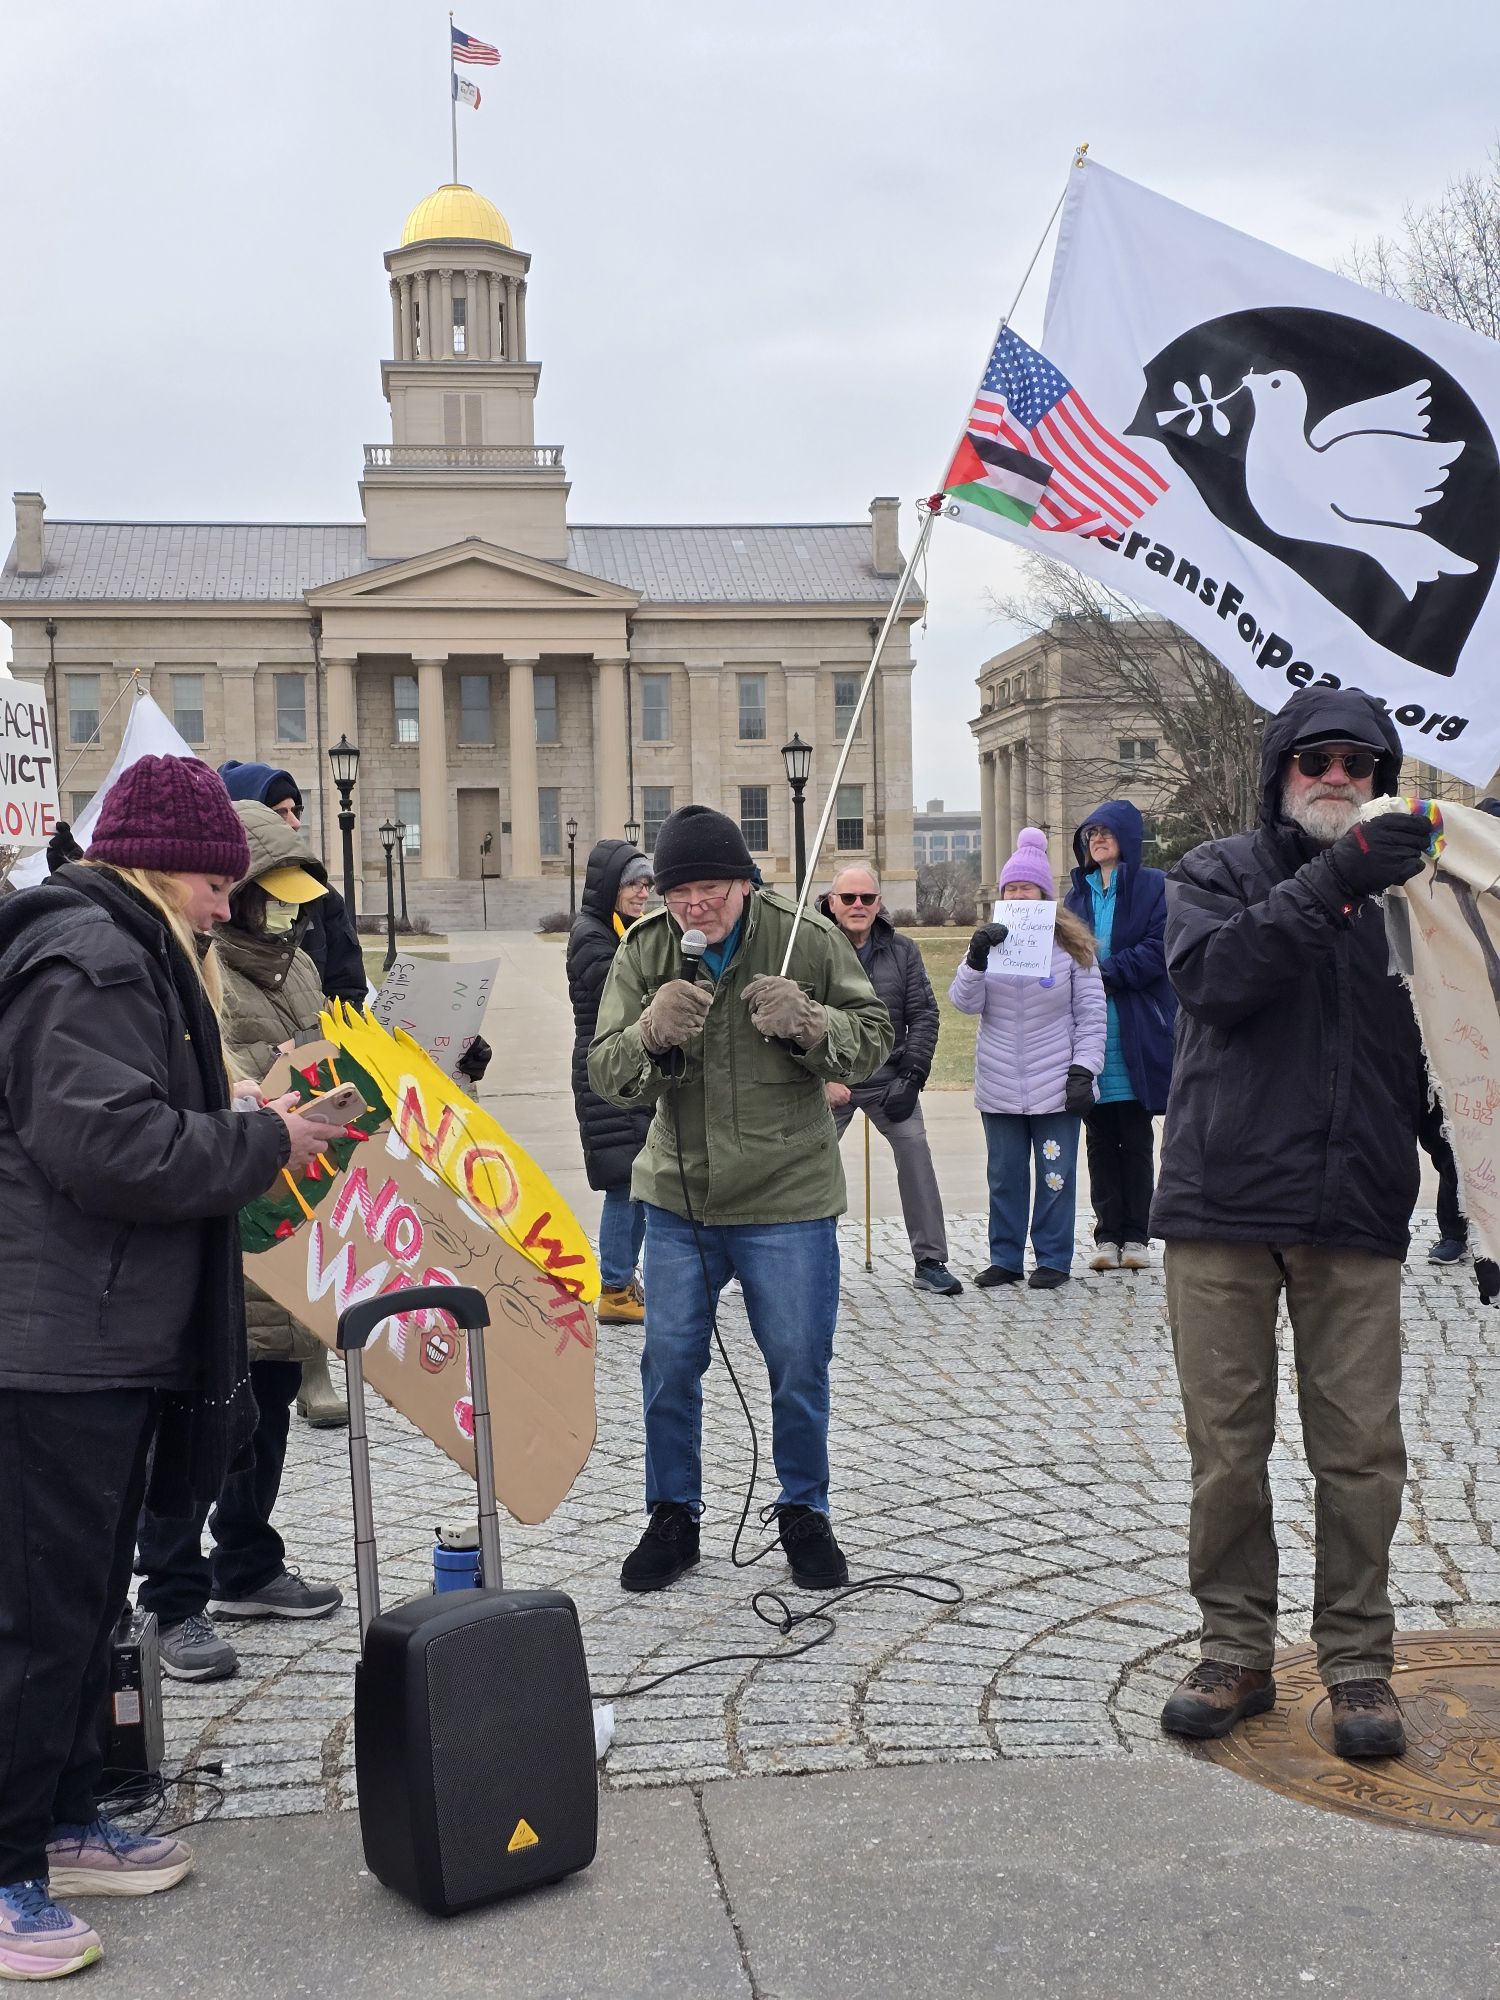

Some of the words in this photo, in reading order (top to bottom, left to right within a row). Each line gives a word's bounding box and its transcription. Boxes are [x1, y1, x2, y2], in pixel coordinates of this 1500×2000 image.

[0, 698, 49, 749] ACH
[0, 801, 56, 837] OVE
[1005, 903, 1030, 917] Money
[1034, 903, 1046, 914] for
[1002, 957, 1040, 969] Occupation
[398, 1084, 520, 1220] NO
[329, 1165, 425, 1269] NO
[522, 1210, 595, 1358] WAR
